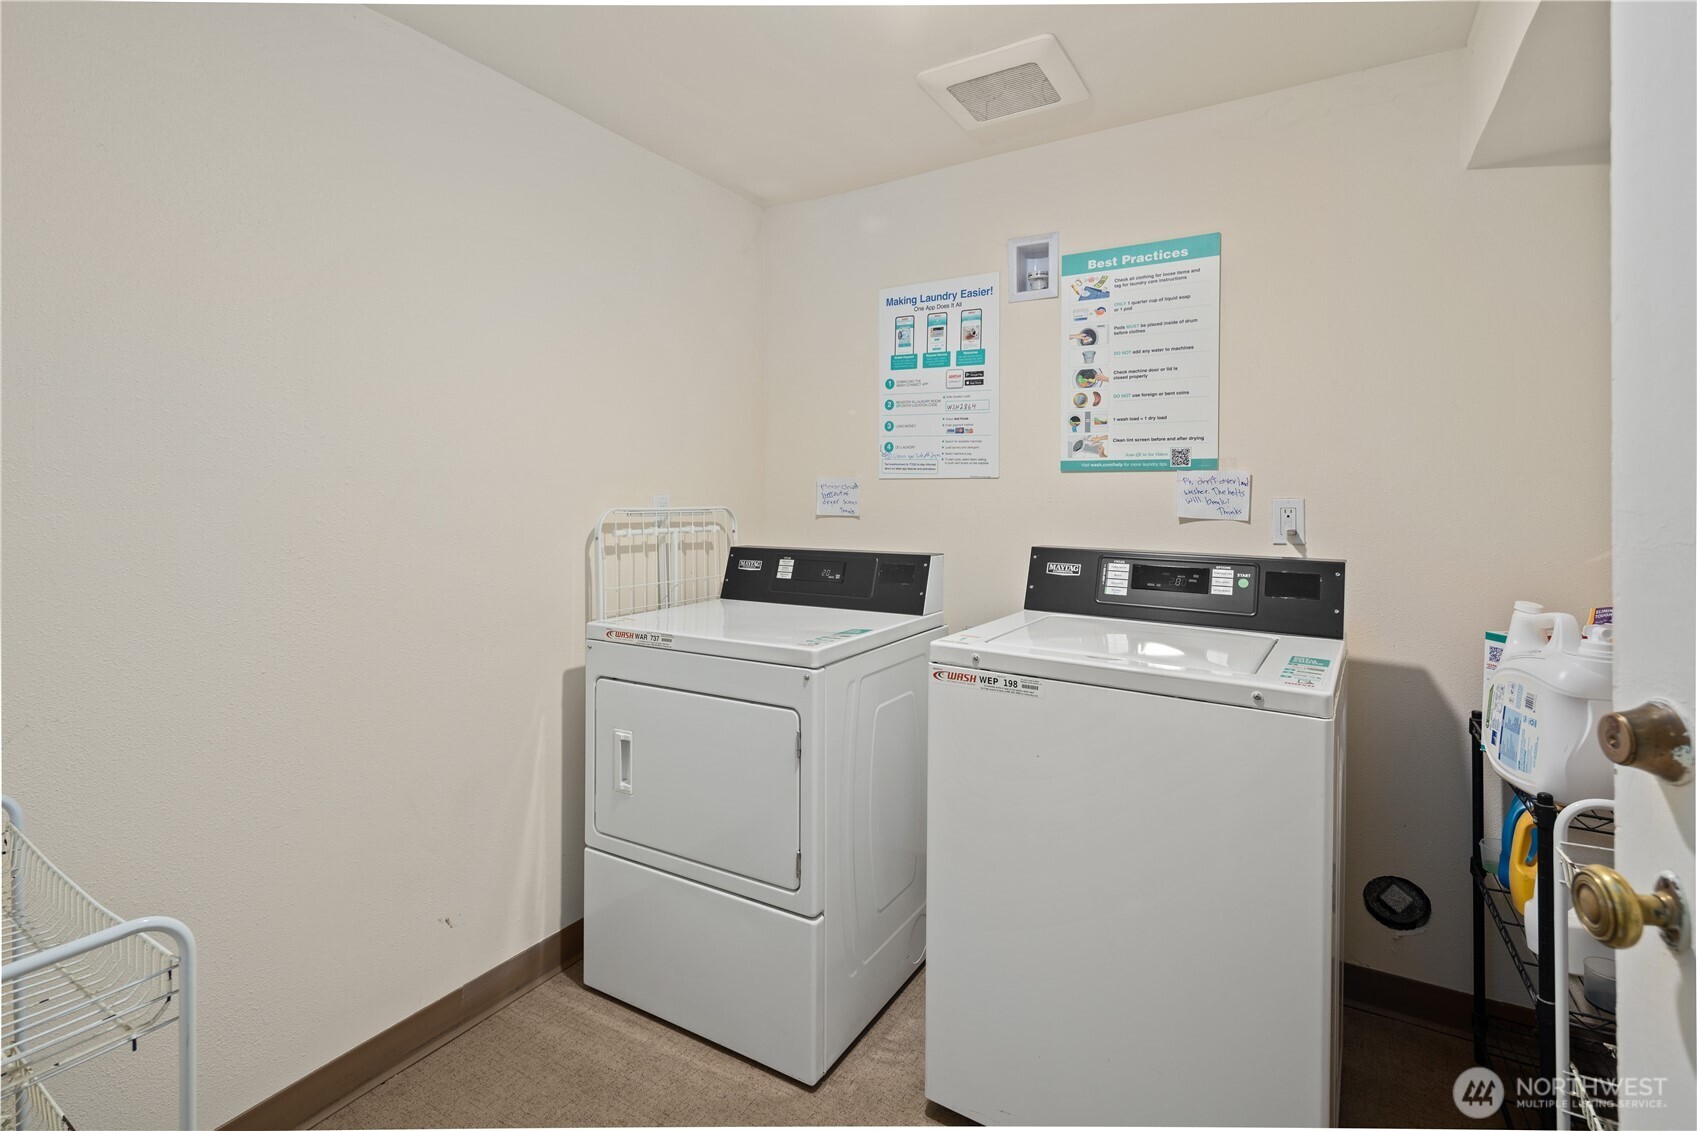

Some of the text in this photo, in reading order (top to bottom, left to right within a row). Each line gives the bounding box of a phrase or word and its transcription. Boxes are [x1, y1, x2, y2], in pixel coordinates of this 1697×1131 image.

[1088, 249, 1188, 269] Best Practices
[886, 287, 993, 306] Making Laundry Easier!
[1211, 486, 1227, 495] The
[1227, 487, 1245, 497] belts
[1216, 506, 1242, 515] Thanks
[821, 569, 831, 577] 20
[615, 631, 634, 639] WASH
[947, 671, 977, 683] WASH
[979, 675, 999, 685] WEP
[1003, 679, 1018, 688] 198
